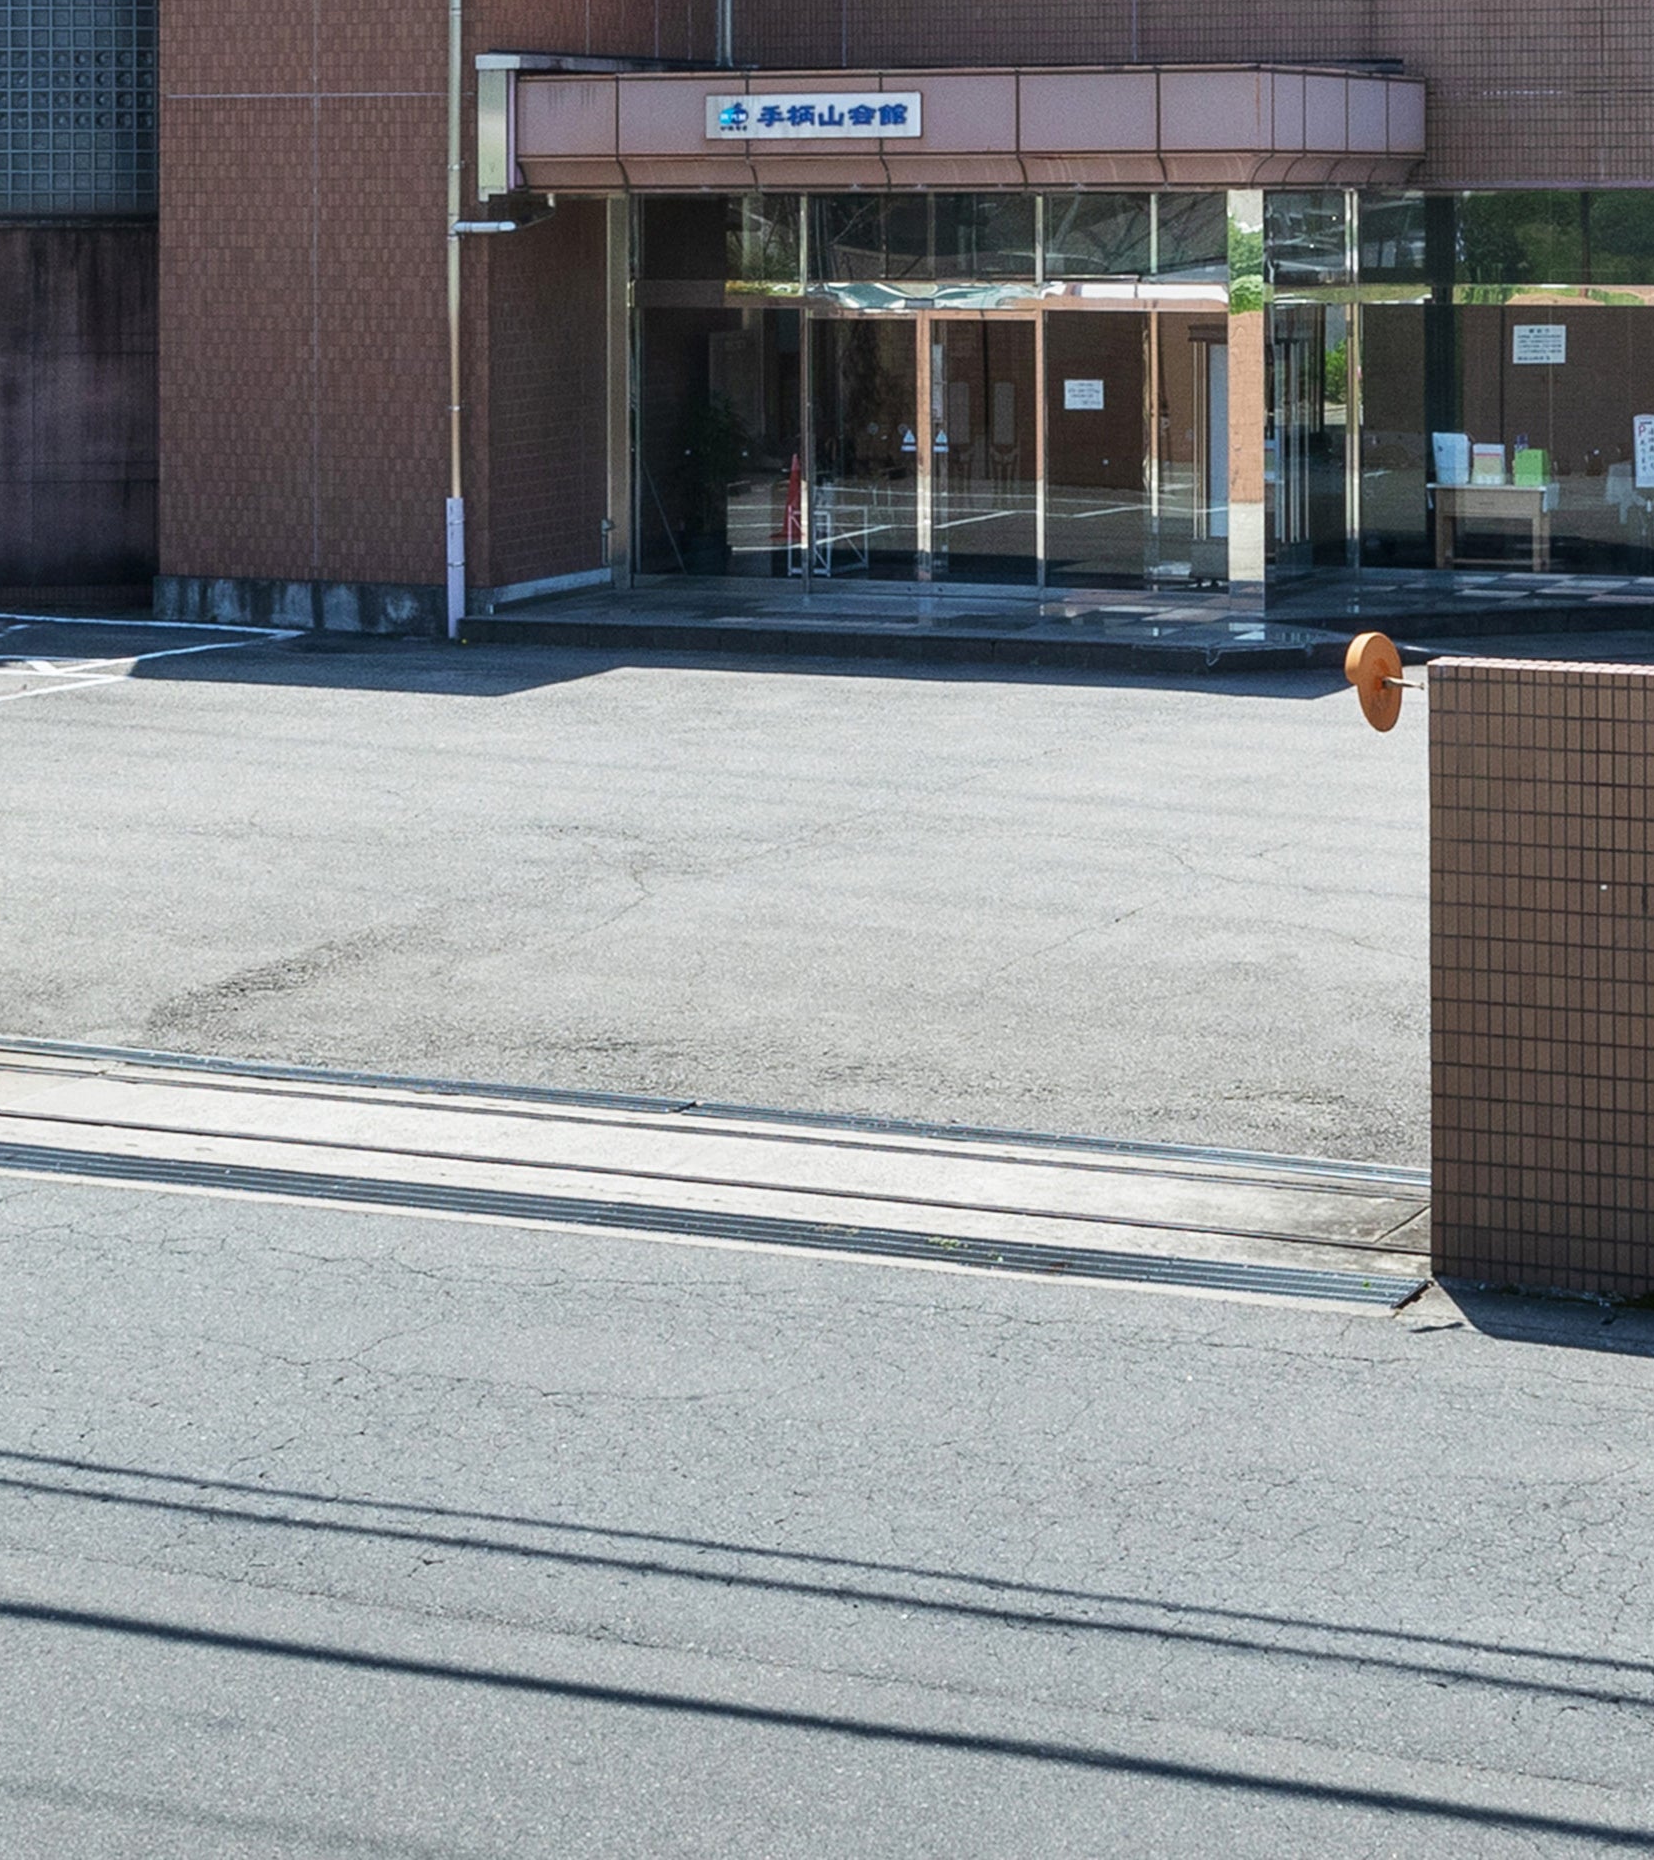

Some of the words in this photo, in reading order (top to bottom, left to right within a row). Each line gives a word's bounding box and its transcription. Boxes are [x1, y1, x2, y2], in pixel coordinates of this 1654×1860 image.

[756, 103, 908, 128] 手柄山会館
